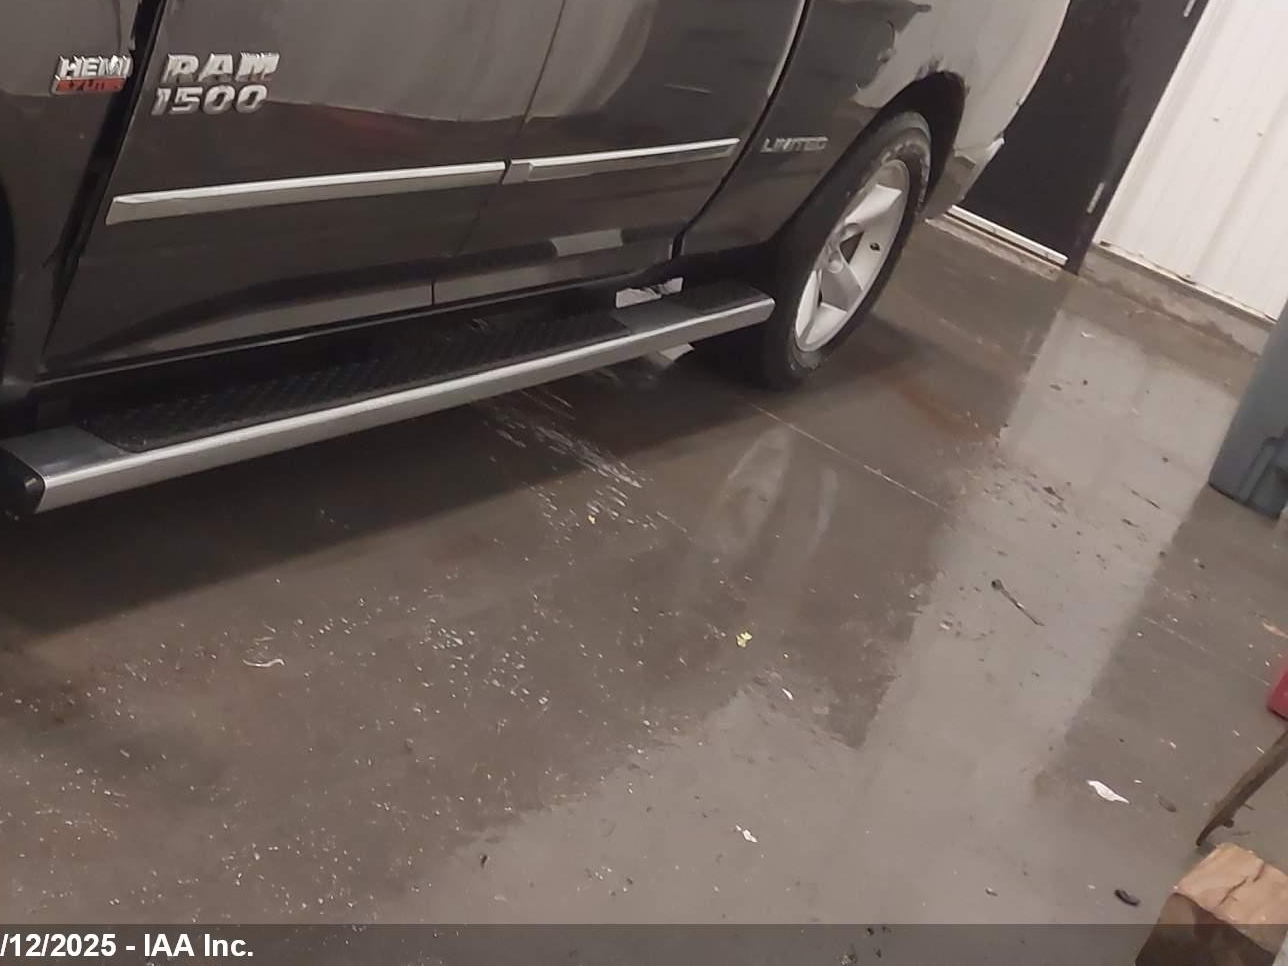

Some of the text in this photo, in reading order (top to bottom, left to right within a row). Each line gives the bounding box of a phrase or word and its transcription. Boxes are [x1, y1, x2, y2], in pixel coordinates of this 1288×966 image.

[57, 55, 132, 78] HEMI
[162, 52, 281, 84] RAM
[151, 84, 269, 115] 1500
